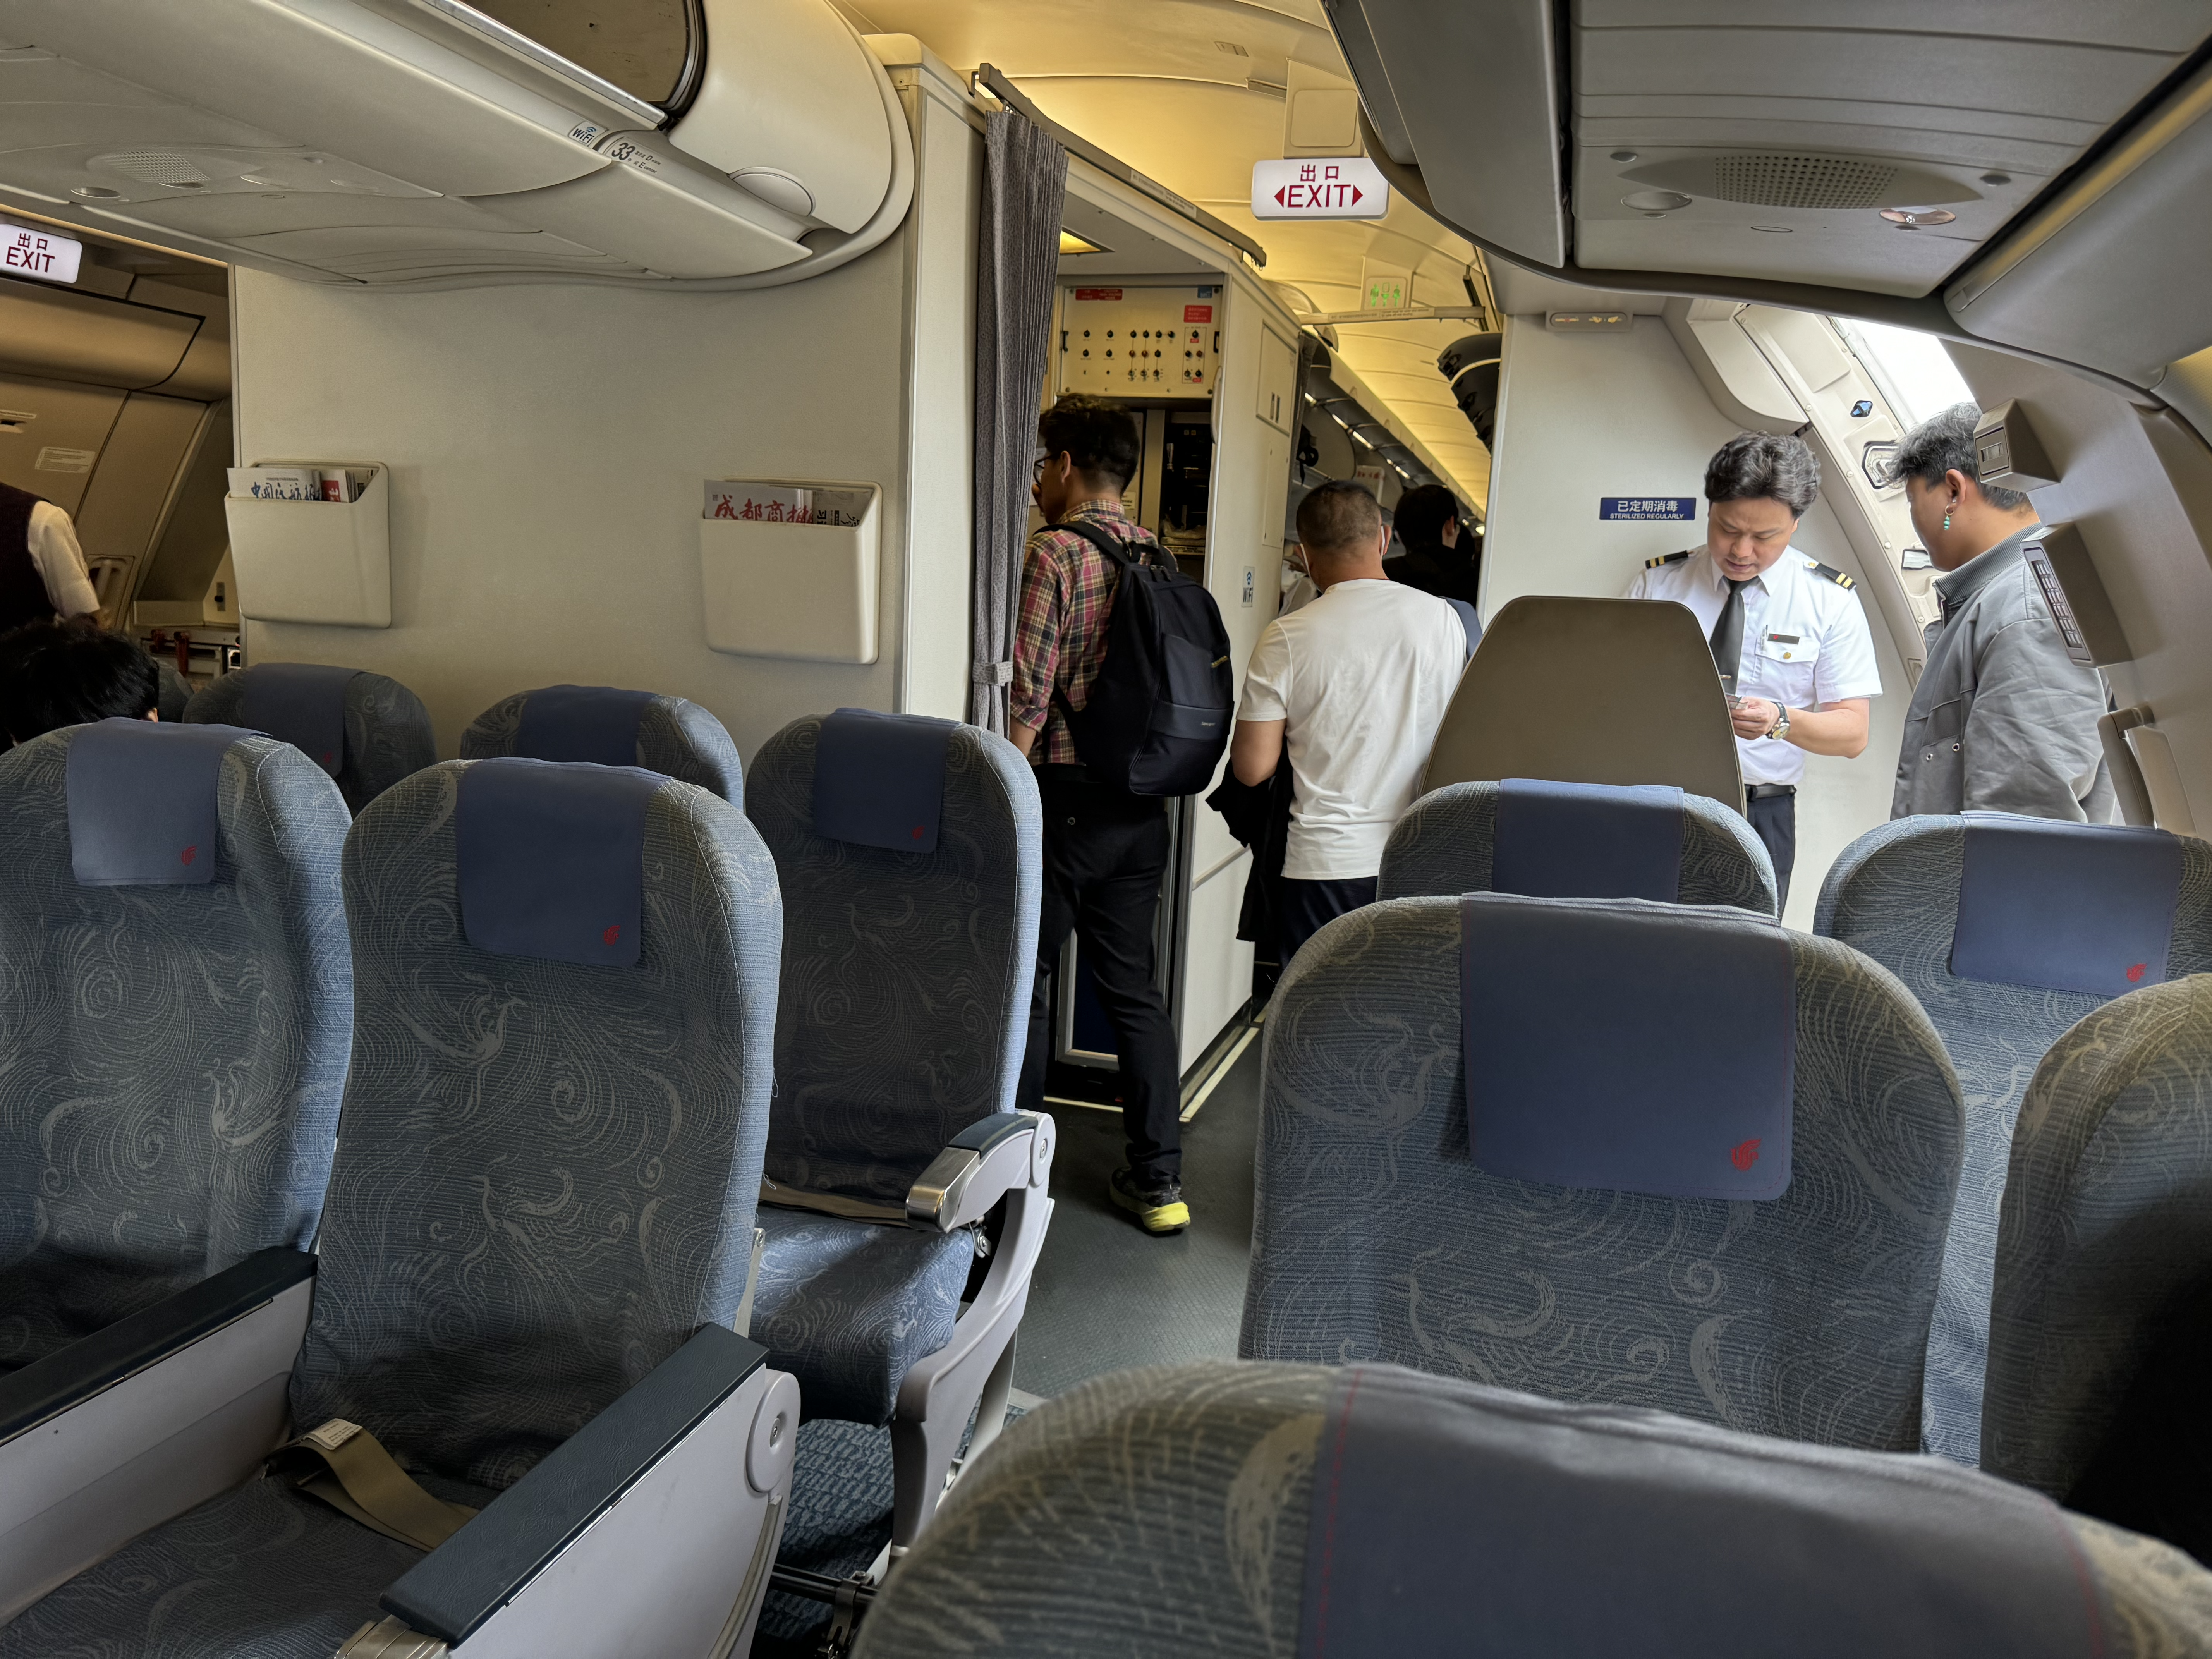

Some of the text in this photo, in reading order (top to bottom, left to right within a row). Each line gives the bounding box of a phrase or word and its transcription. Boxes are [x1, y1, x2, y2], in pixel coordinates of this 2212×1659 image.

[572, 128, 595, 143] WiFi
[611, 143, 636, 160] 33
[1300, 164, 1339, 182] 出口
[1288, 184, 1352, 208] EXIT
[17, 233, 48, 251] 出口
[6, 246, 55, 273] EXIT
[1618, 500, 1678, 512] 已定期消毒
